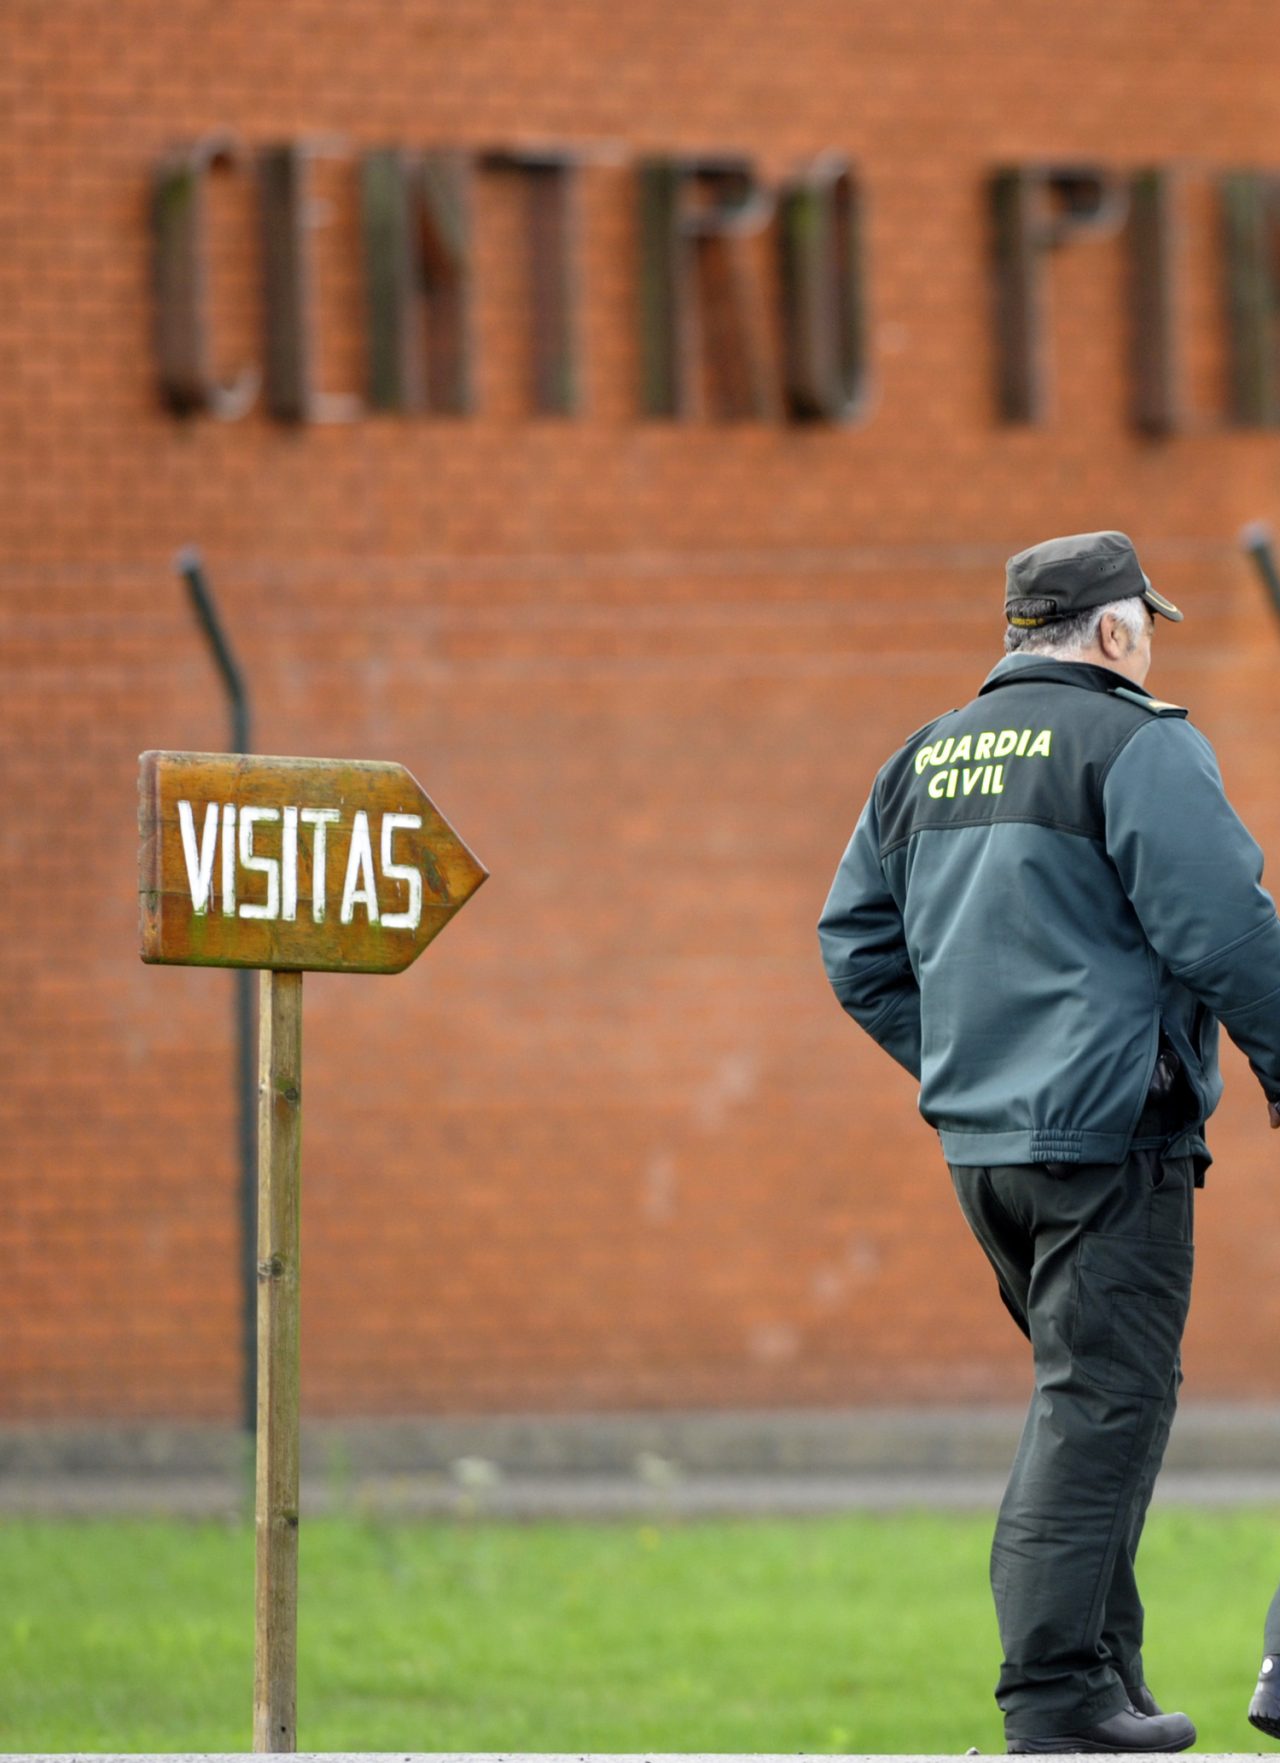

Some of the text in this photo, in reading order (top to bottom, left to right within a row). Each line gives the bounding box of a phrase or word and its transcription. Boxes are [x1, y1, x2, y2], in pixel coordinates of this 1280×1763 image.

[148, 134, 868, 428] CENTRO
[914, 729, 1052, 775] GUARDIA
[928, 764, 1004, 799] CIVIL
[177, 800, 422, 928] VISITAS
